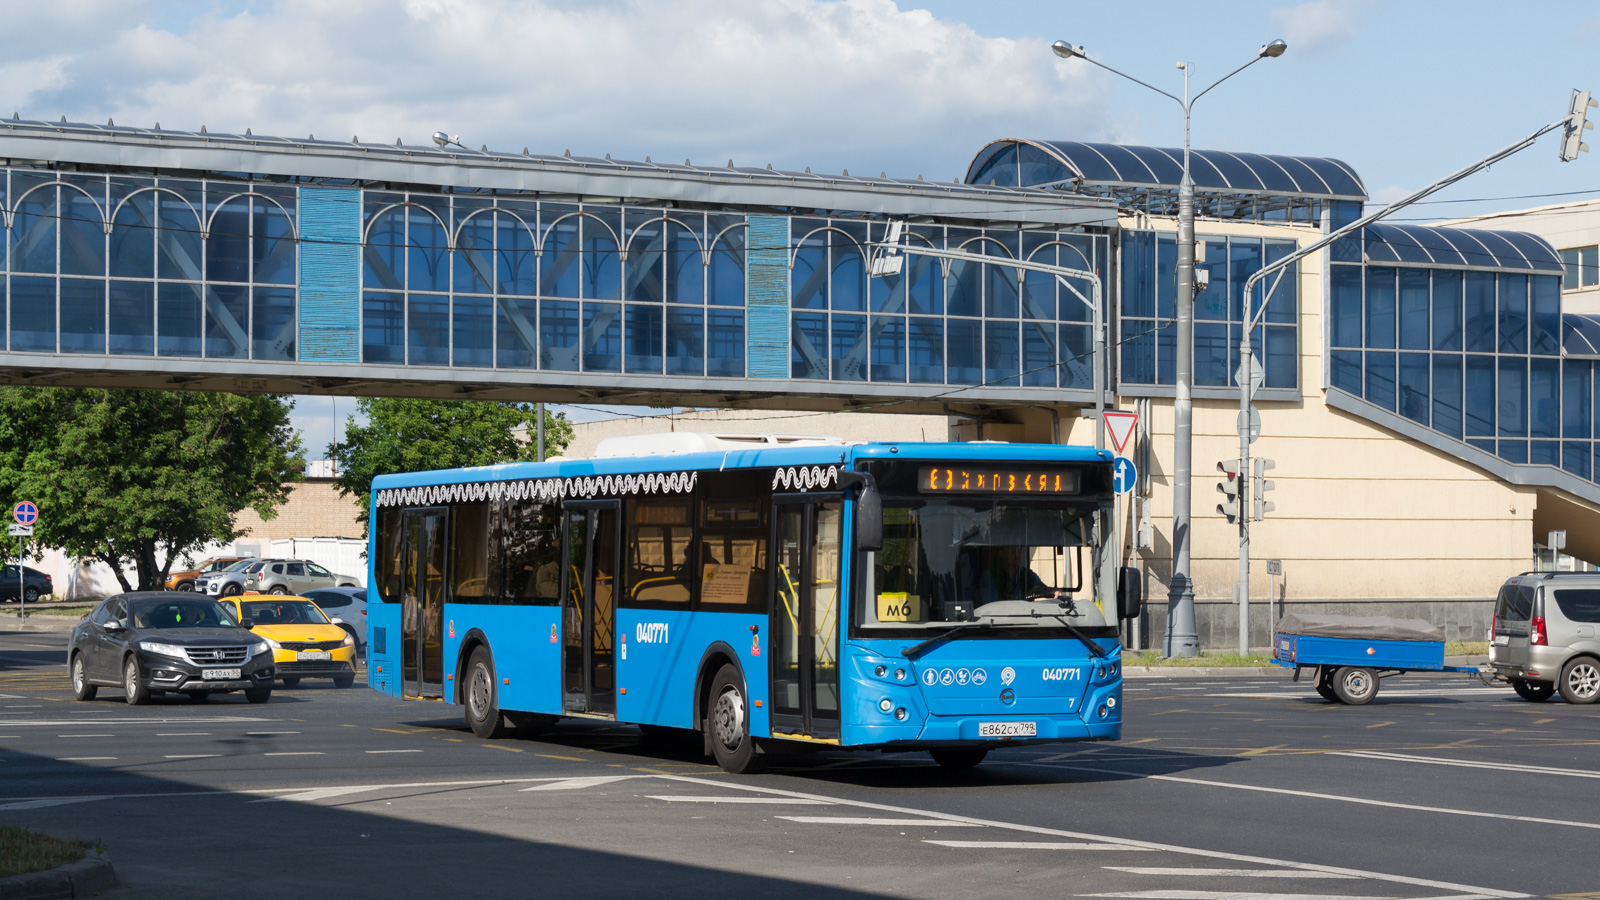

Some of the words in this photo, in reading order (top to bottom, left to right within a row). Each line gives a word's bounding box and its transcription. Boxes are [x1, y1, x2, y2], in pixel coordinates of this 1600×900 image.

[636, 622, 669, 644] 040771
[1042, 668, 1081, 681] 040771
[1068, 698, 1075, 708] 7
[1020, 723, 1034, 732] 799
